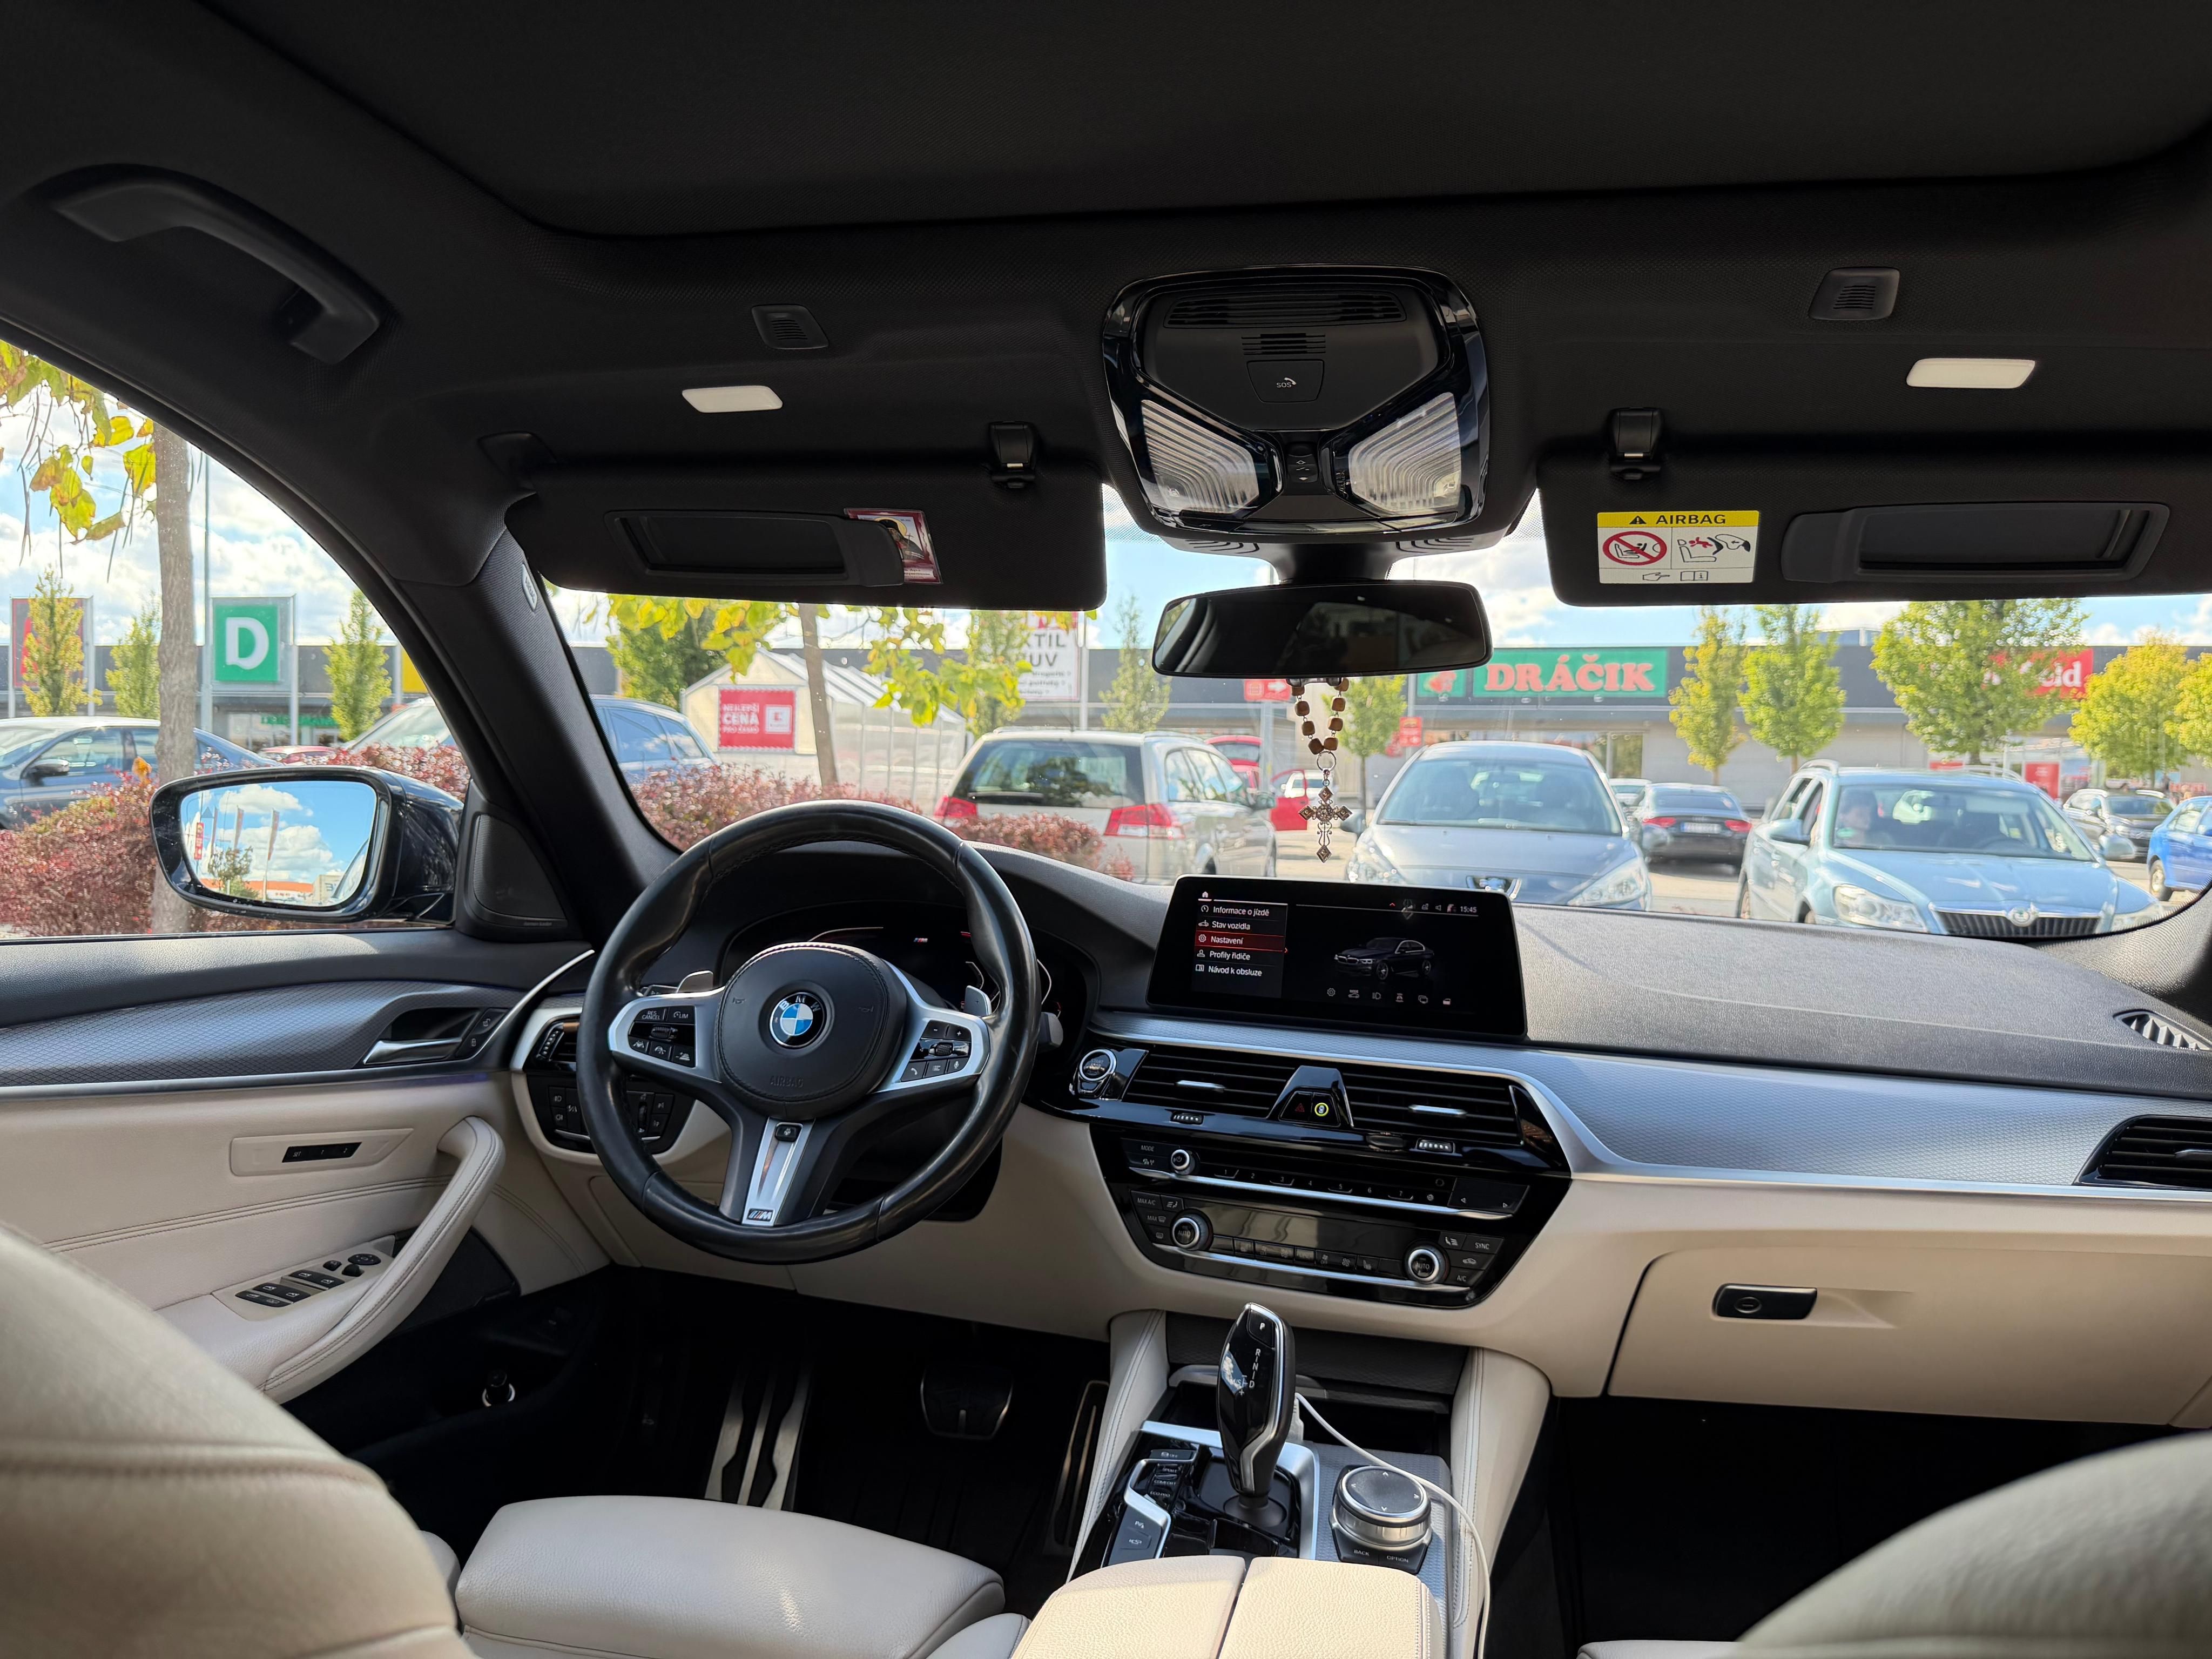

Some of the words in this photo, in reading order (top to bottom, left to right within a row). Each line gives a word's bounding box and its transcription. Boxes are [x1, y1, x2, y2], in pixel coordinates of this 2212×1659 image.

[1656, 514, 1726, 525] AIRBAG
[226, 617, 269, 670] D
[1027, 633, 1067, 648] TIL
[1030, 652, 1057, 667] UV
[1485, 655, 1655, 692] DRÁČIK
[723, 712, 759, 725] CENA
[1213, 906, 1246, 915] Informace
[1253, 908, 1270, 917] jízdě
[1211, 936, 1244, 945] Nastavení
[1209, 950, 1231, 960] Profily
[1208, 965, 1229, 974] Návod
[1236, 968, 1263, 976] obsluze
[779, 995, 821, 1012] BMW
[770, 1075, 804, 1088] AIRBAG
[1255, 1348, 1261, 1357] R
[1252, 1362, 1259, 1371] N
[1249, 1380, 1255, 1388] D
